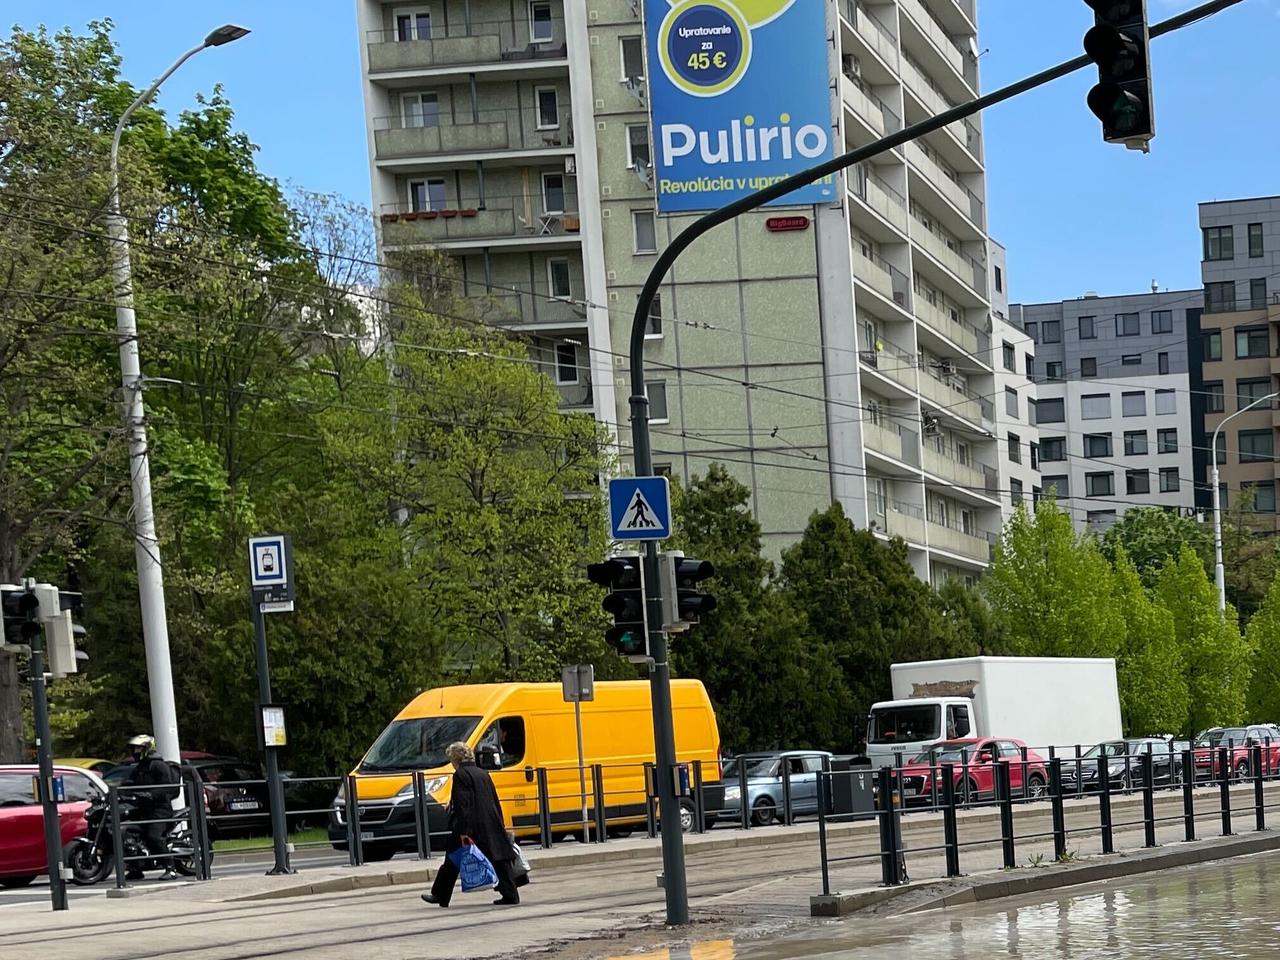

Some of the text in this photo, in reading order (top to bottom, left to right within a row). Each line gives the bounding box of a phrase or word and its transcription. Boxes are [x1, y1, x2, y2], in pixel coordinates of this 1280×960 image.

[679, 25, 731, 38] Upratovanie
[701, 41, 713, 50] za
[687, 51, 727, 70] 45 €
[661, 113, 828, 167] Pulirio
[660, 175, 734, 194] Revolúcia
[736, 177, 746, 189] v
